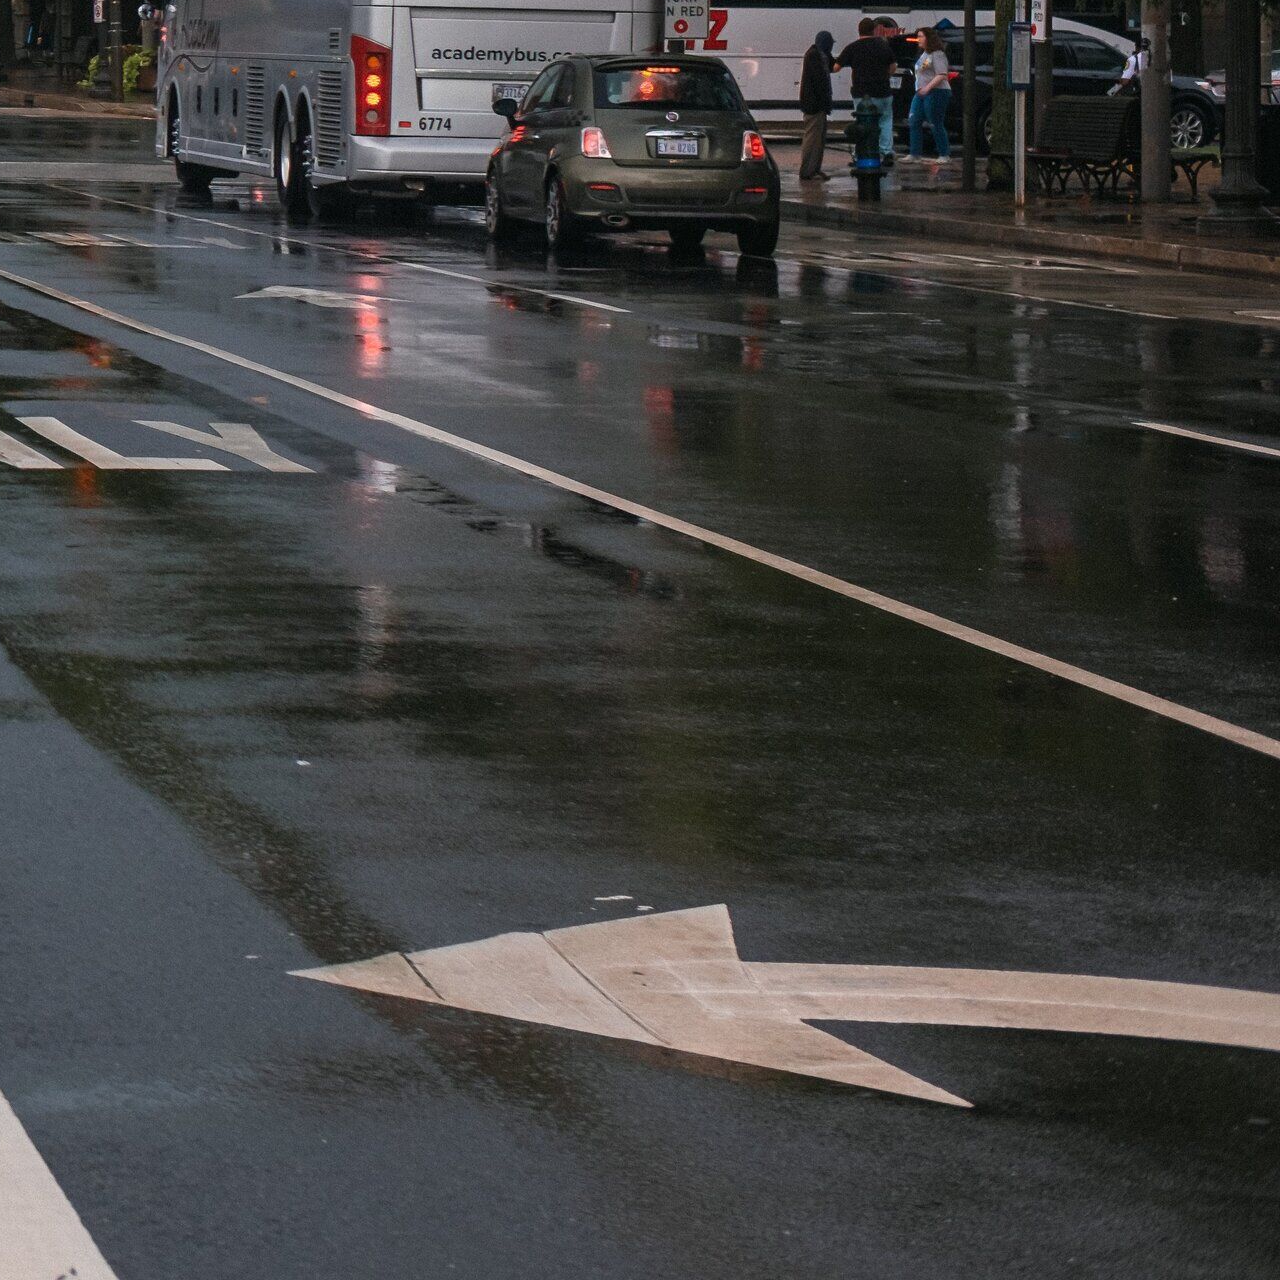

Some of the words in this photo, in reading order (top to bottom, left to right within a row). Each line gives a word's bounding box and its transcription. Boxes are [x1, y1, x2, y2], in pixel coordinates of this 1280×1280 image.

[665, 6, 674, 17] N
[680, 6, 704, 17] RED
[431, 46, 572, 65] academybus.c
[418, 117, 452, 131] 6774
